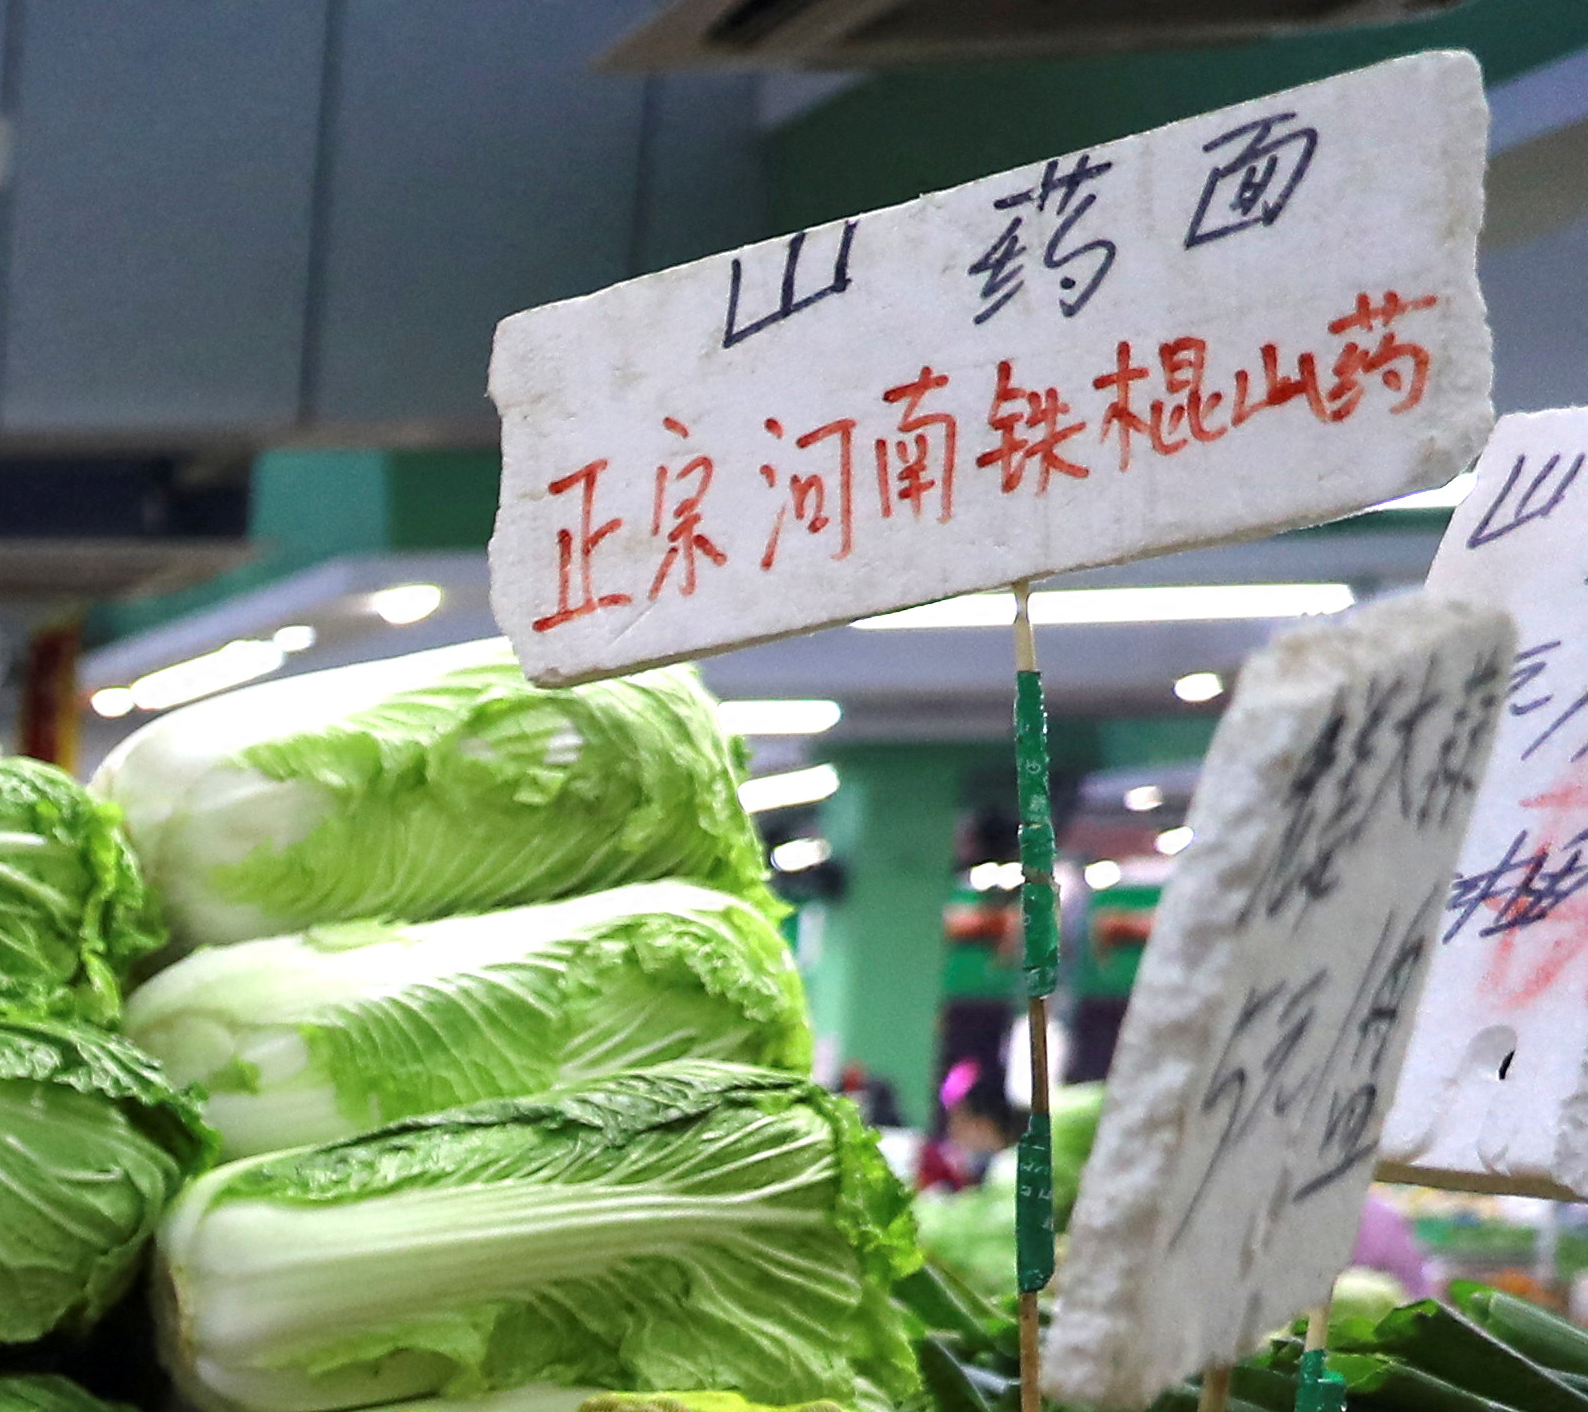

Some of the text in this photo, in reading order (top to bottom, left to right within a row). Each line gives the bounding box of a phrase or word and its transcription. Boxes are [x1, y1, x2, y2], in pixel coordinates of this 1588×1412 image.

[722, 112, 1317, 348] 山药面
[531, 291, 1437, 633] 正宗河南铁棍山药
